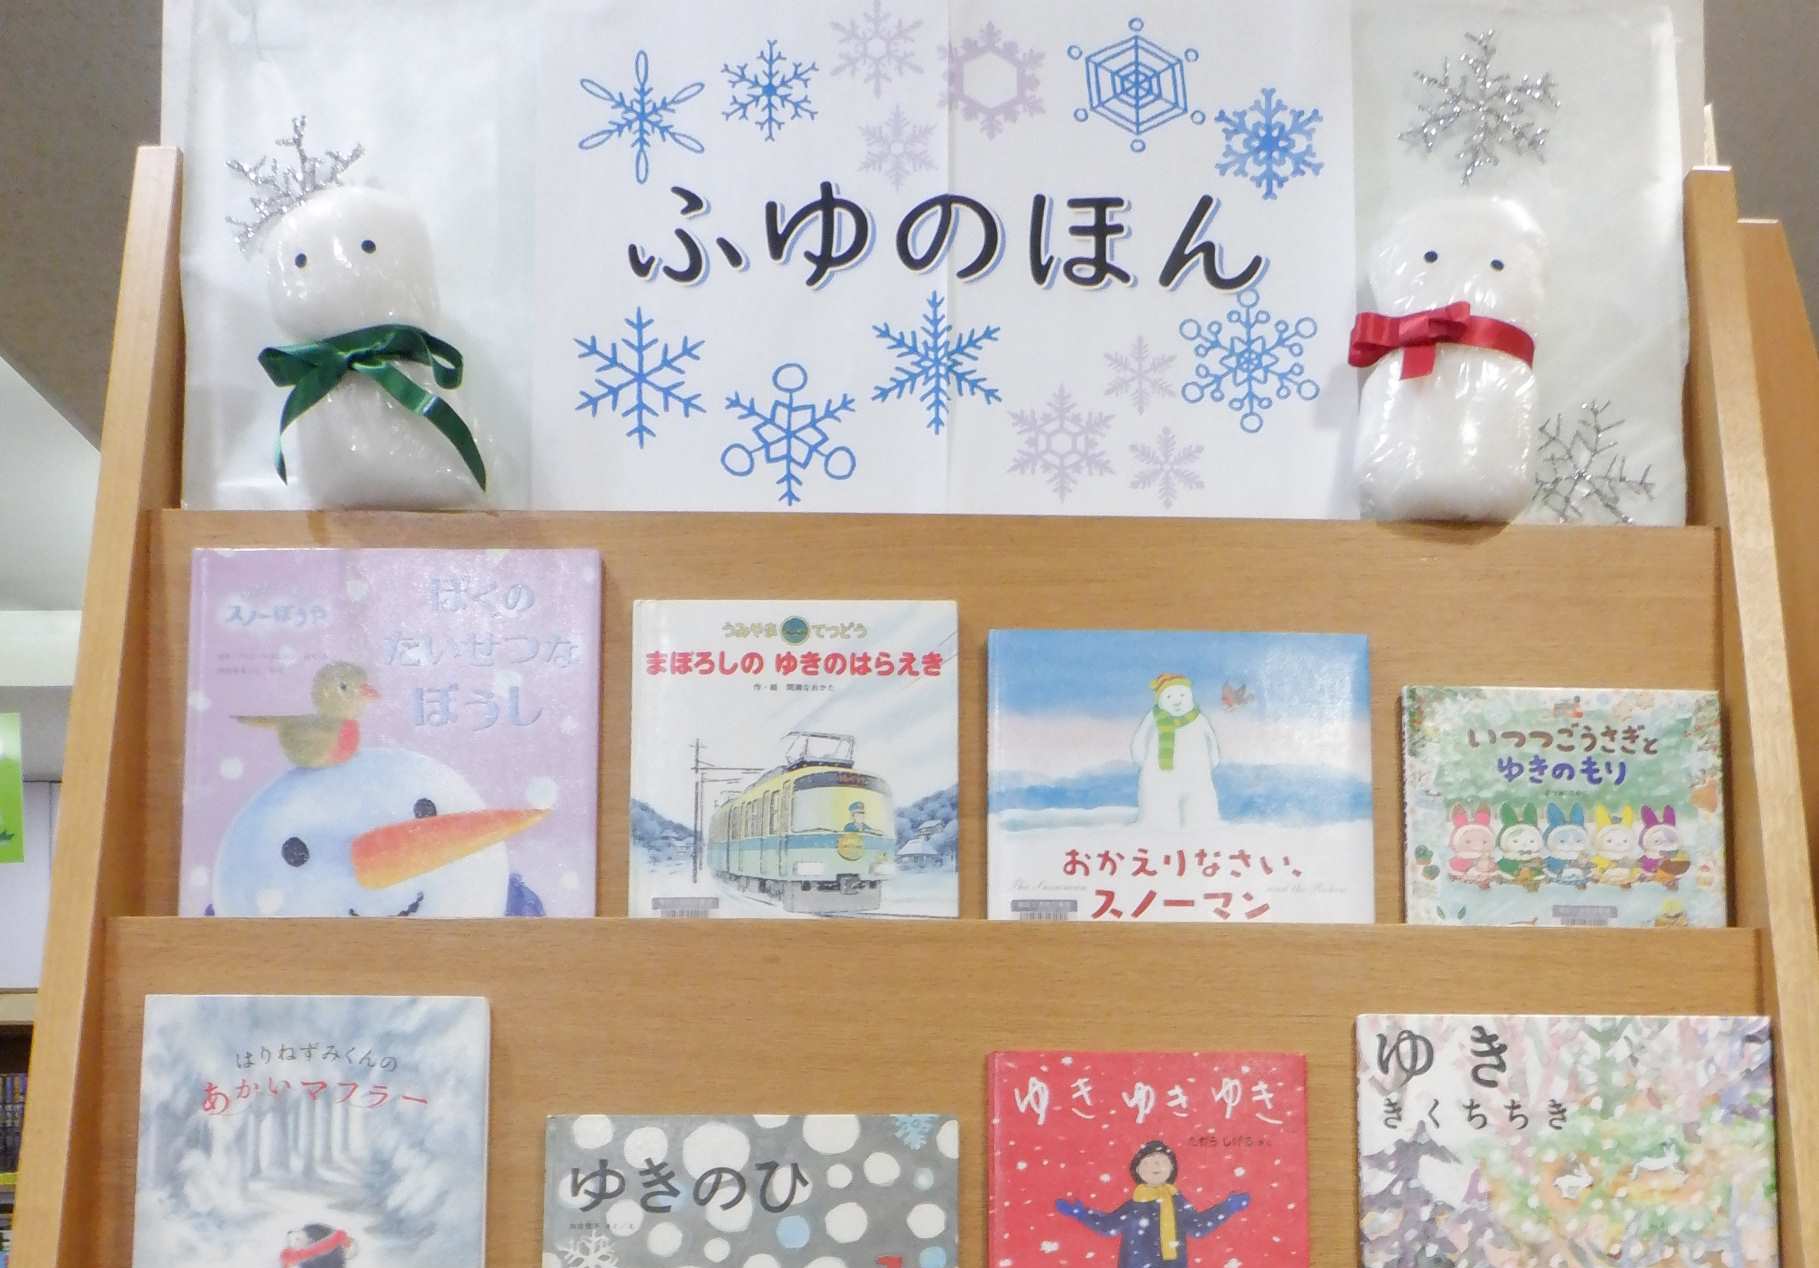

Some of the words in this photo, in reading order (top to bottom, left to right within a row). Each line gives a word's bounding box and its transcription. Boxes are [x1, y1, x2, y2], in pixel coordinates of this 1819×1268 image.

[627, 180, 1269, 291] ふゆのほん
[645, 651, 764, 676] まぼろしの
[774, 651, 944, 677] ゆきのはらえき
[1467, 722, 1659, 755] いつつごうさぎと
[1497, 755, 1627, 785] ゆきのもり
[1091, 889, 1271, 919] スノーマン
[235, 1042, 398, 1073] はりねずみくんの
[1375, 1024, 1509, 1088] ゆき
[201, 1077, 429, 1115] あかいマフラー
[1014, 1076, 1096, 1126] ゆき
[1121, 1081, 1189, 1124] ゆき
[1212, 1077, 1284, 1124] ゆき
[1382, 1098, 1569, 1131] きくちちき
[571, 1156, 810, 1214] ゆきのひ
